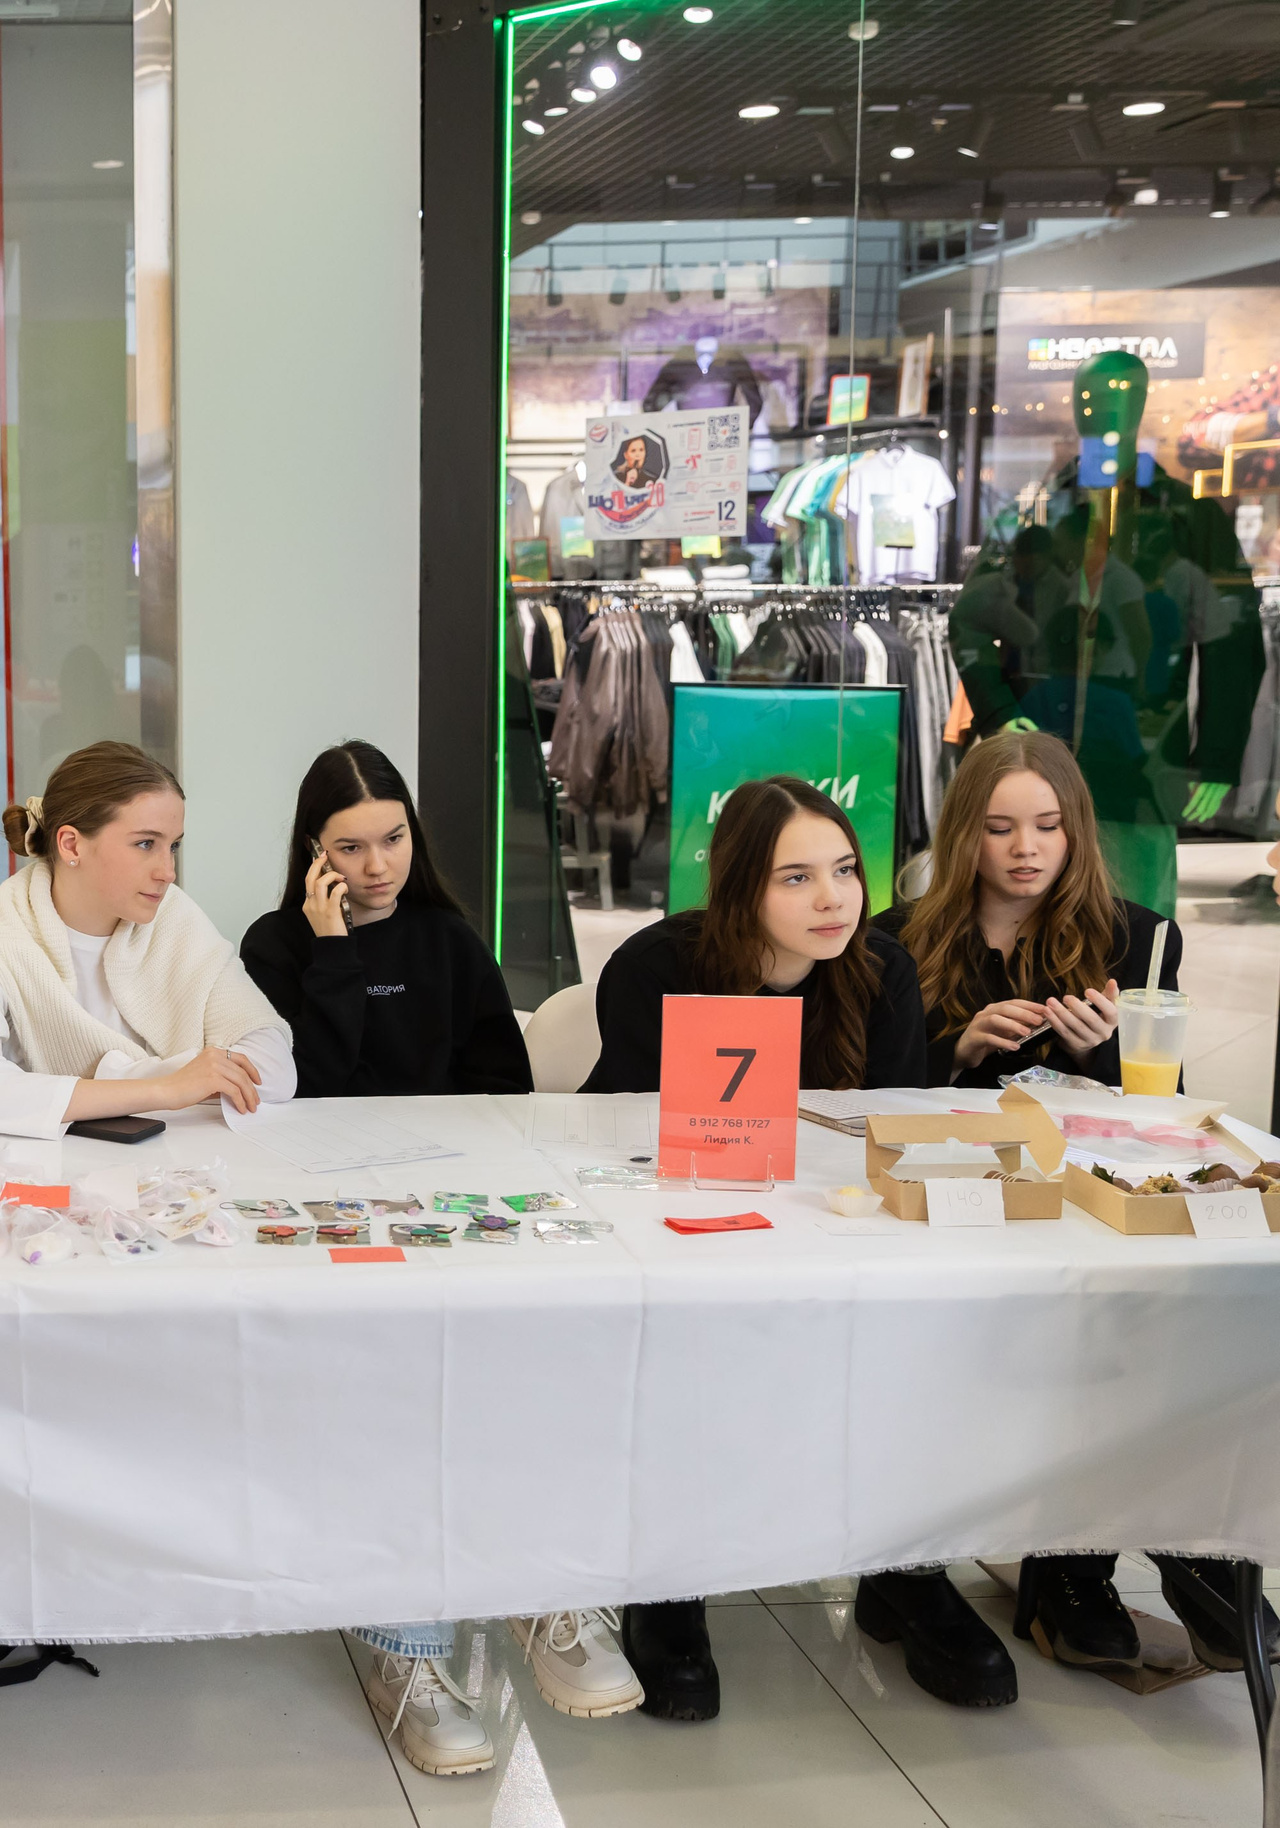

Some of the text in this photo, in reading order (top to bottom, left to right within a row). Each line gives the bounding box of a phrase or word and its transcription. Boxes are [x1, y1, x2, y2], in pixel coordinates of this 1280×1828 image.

[718, 500, 736, 521] 12
[715, 1047, 757, 1103] 7
[689, 1117, 770, 1129] 8 912 768 1727
[703, 1134, 755, 1146] Лидия К.
[946, 1190, 983, 1208] 140
[1205, 1204, 1248, 1220] 200
